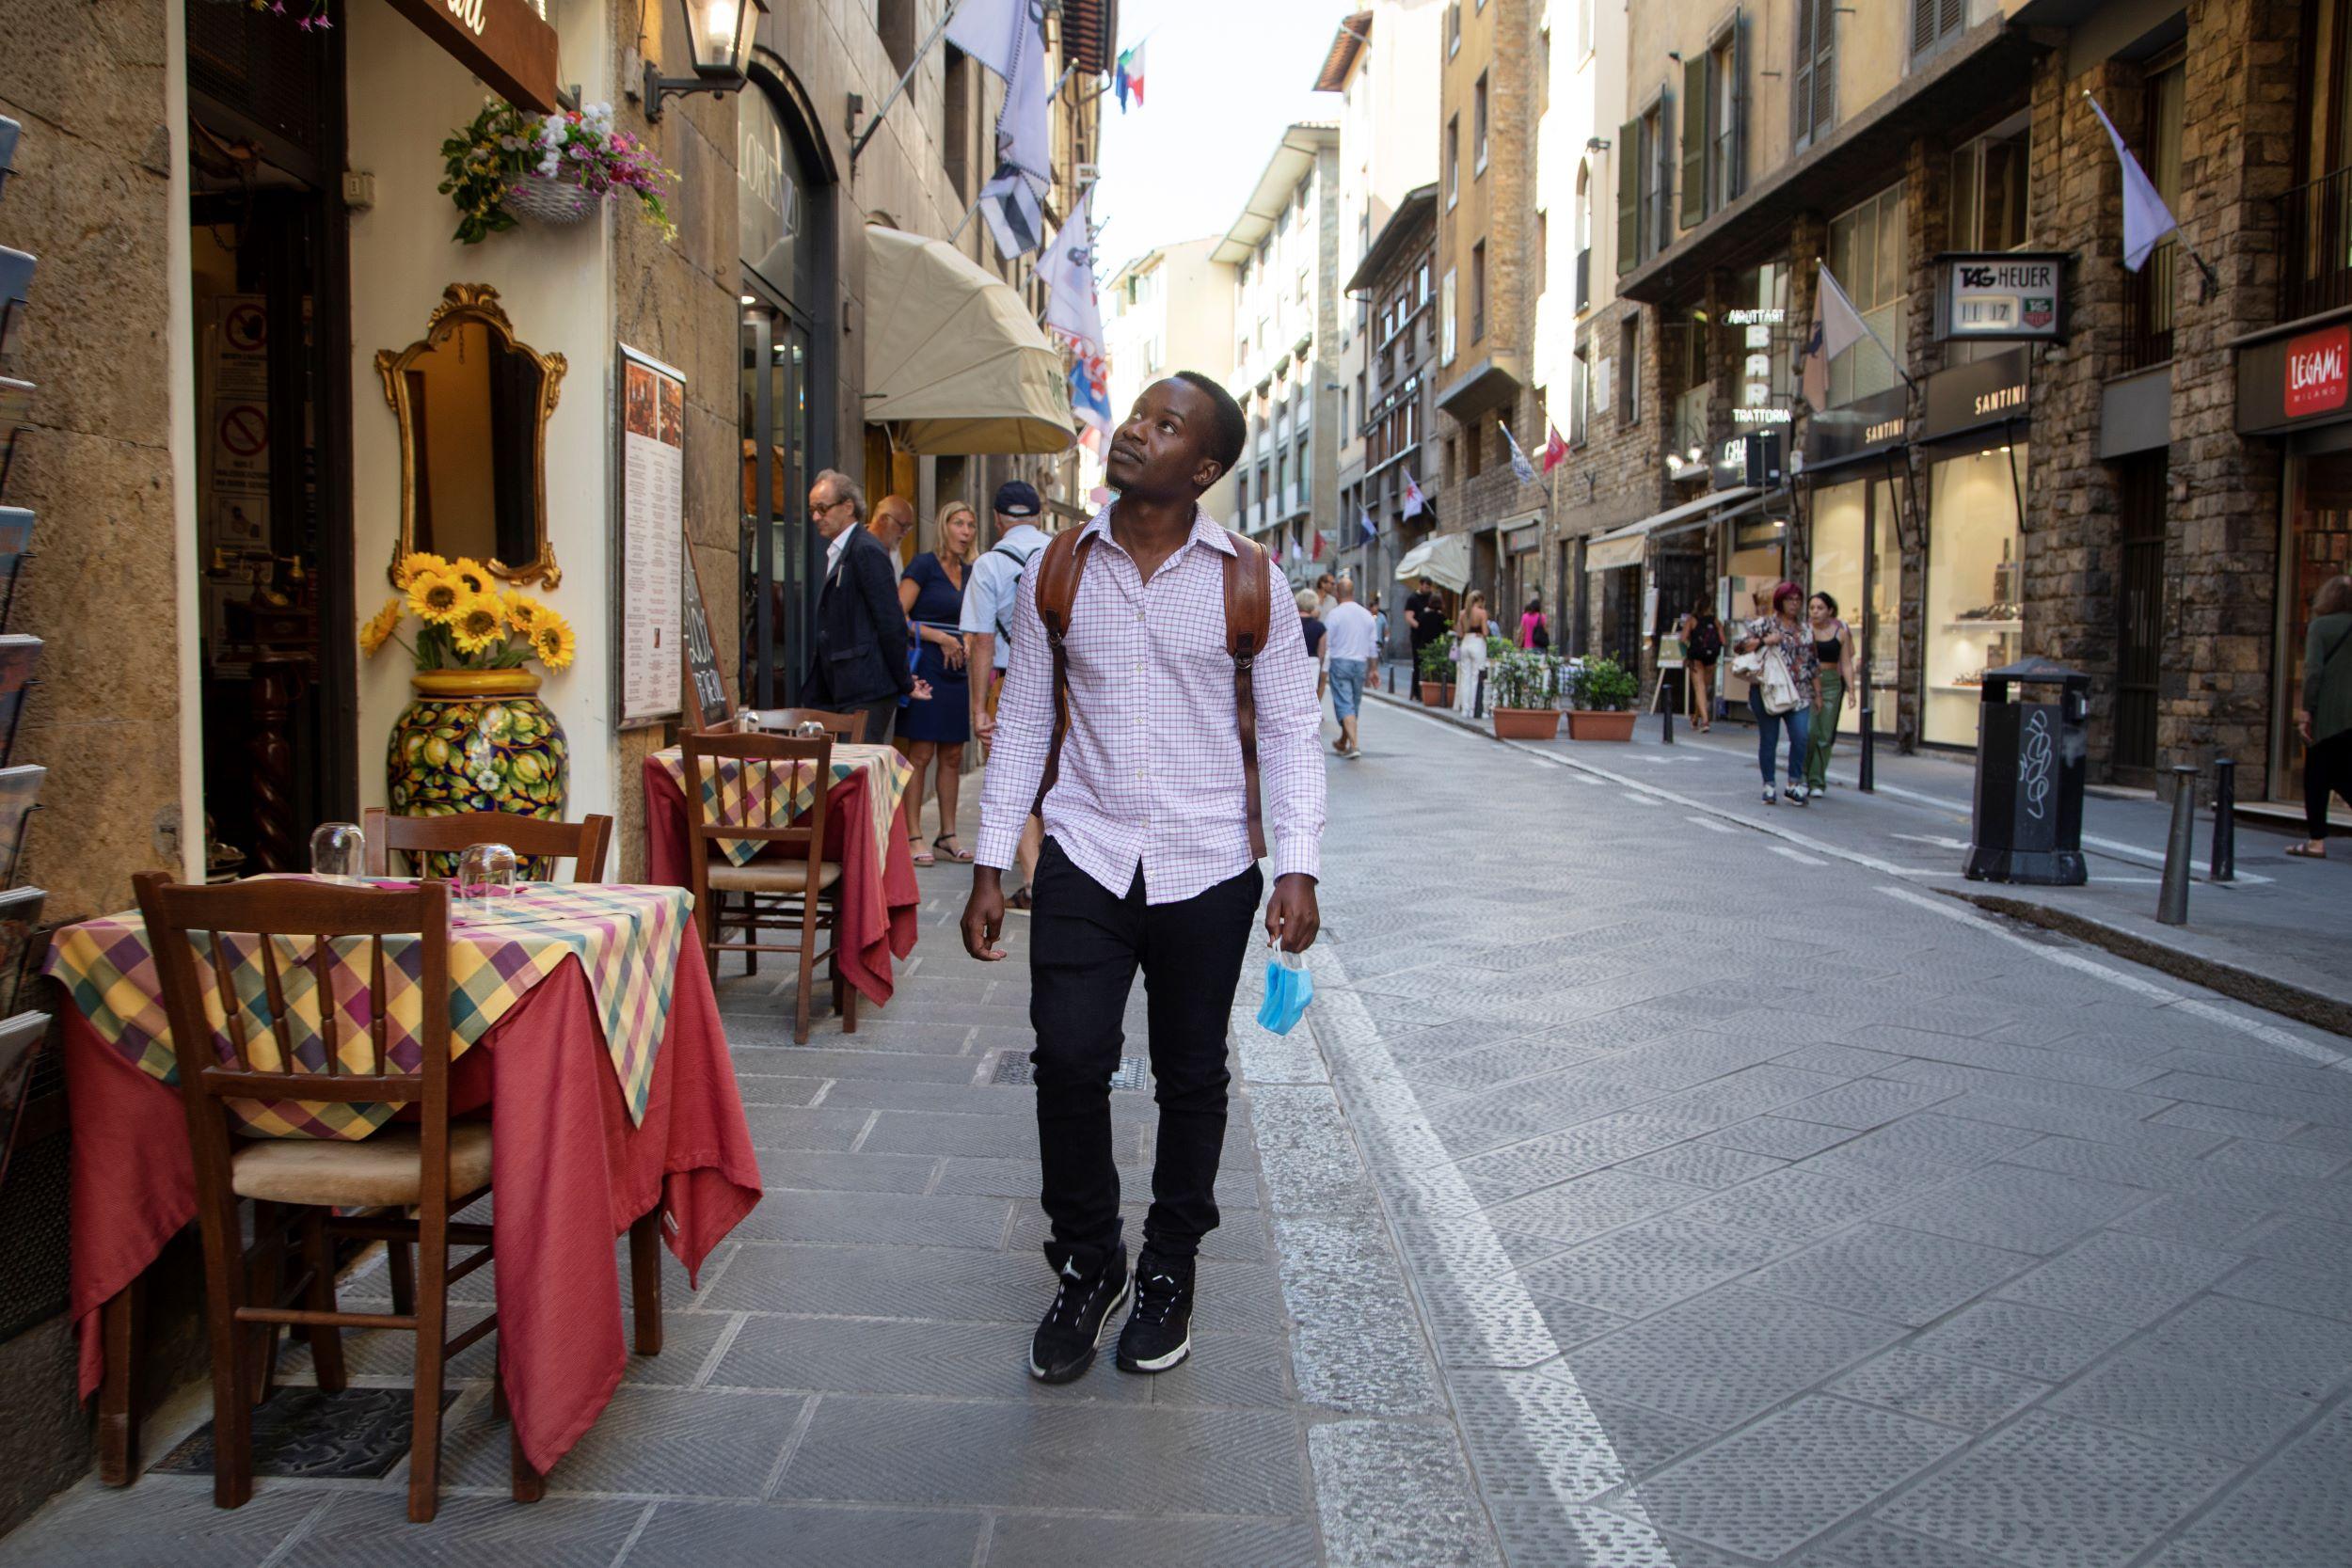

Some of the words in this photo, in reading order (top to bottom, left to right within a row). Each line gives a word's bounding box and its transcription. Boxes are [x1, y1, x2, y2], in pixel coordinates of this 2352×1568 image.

[1960, 266, 1996, 288] TAG
[1997, 266, 2051, 288] HEUER
[1745, 325, 1771, 406] BAR
[1975, 384, 2026, 416] SANTINI
[2294, 386, 2337, 403] MILANO
[1733, 408, 1791, 423] TRATTORIA
[1866, 418, 1904, 444] SANTINI
